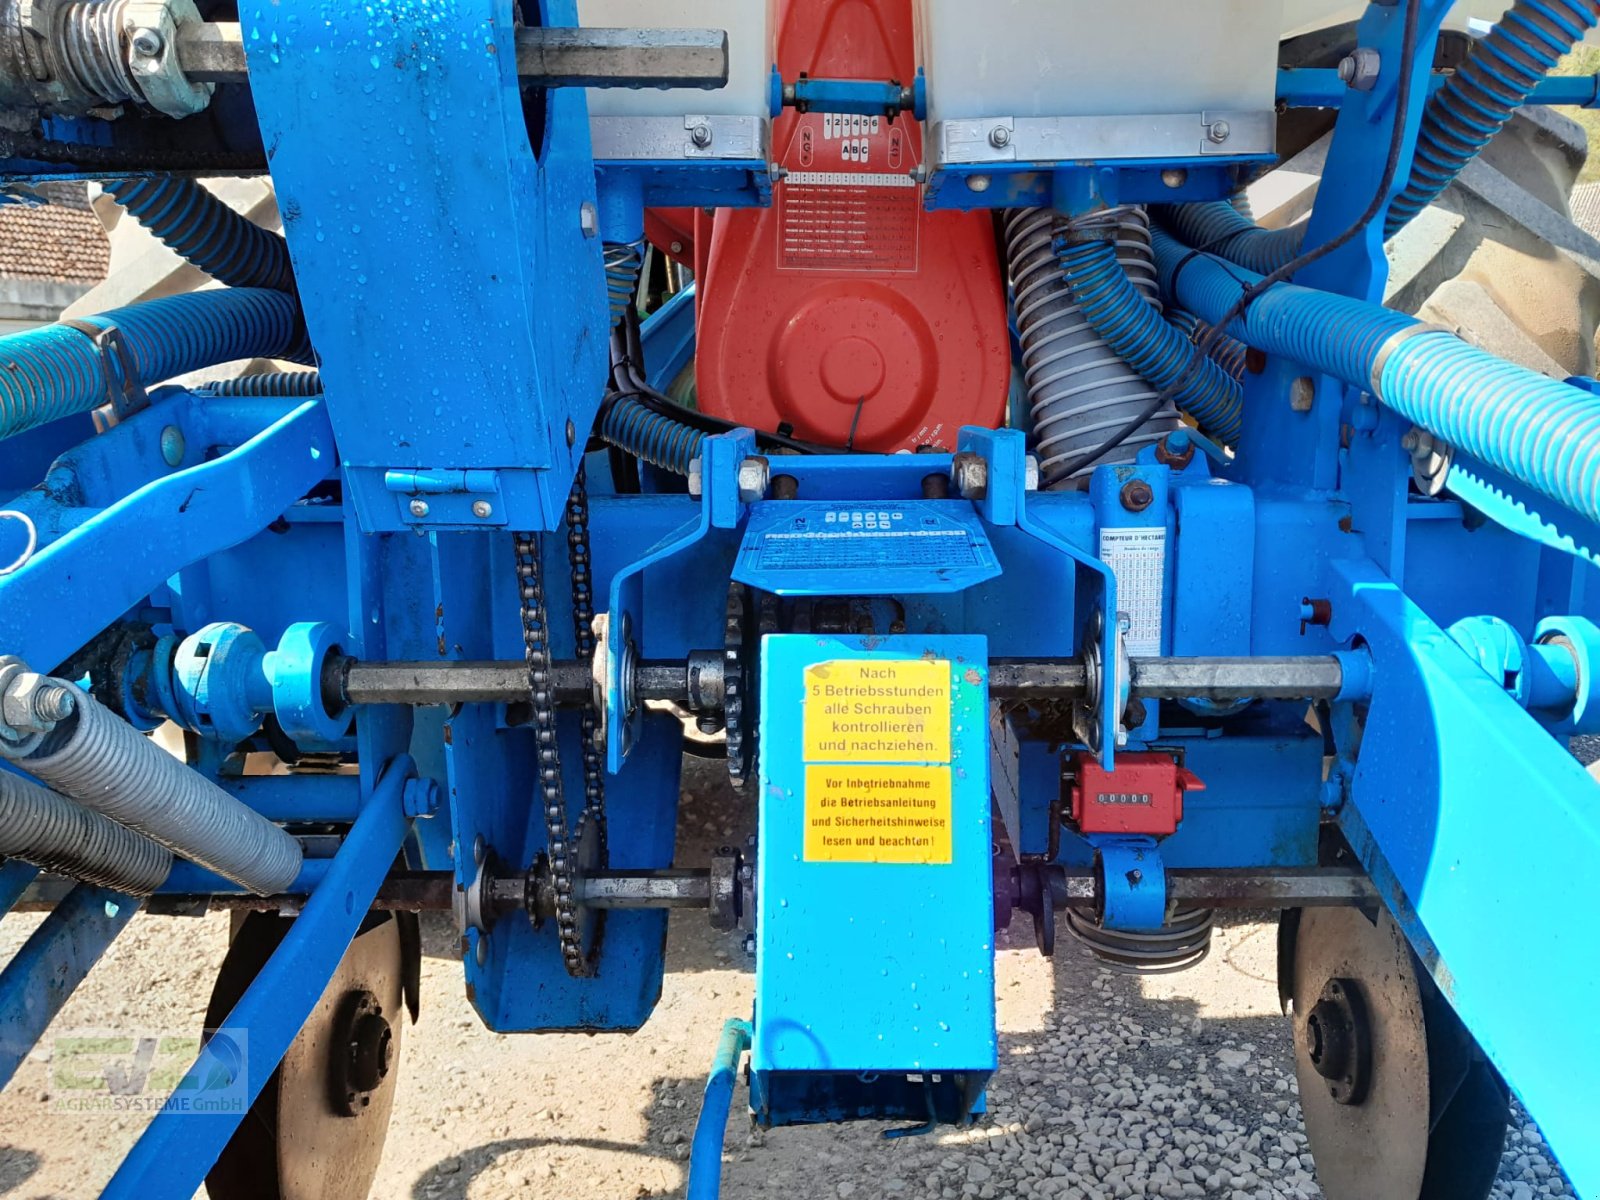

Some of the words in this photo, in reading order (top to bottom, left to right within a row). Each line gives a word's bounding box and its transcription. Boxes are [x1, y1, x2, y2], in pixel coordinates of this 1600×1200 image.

[842, 146, 849, 154] A
[852, 146, 858, 154] B
[861, 146, 868, 154] C
[860, 667, 896, 679] Nach
[812, 685, 820, 697] 5
[825, 684, 944, 697] Betriebsstunden
[824, 703, 849, 715] alle
[854, 703, 932, 715] Schrauben
[832, 721, 924, 733] kontrollieren
[819, 740, 846, 751] und
[851, 739, 938, 751] nachziehen.
[825, 778, 843, 789] Vor
[846, 778, 931, 789] Inbetriebnahme
[820, 797, 837, 808] die
[840, 797, 936, 809] Betriebsanleitung
[812, 816, 831, 827] und
[835, 816, 946, 828] Sicherheitshinweise
[822, 835, 851, 846] lesen
[856, 835, 875, 846] und
